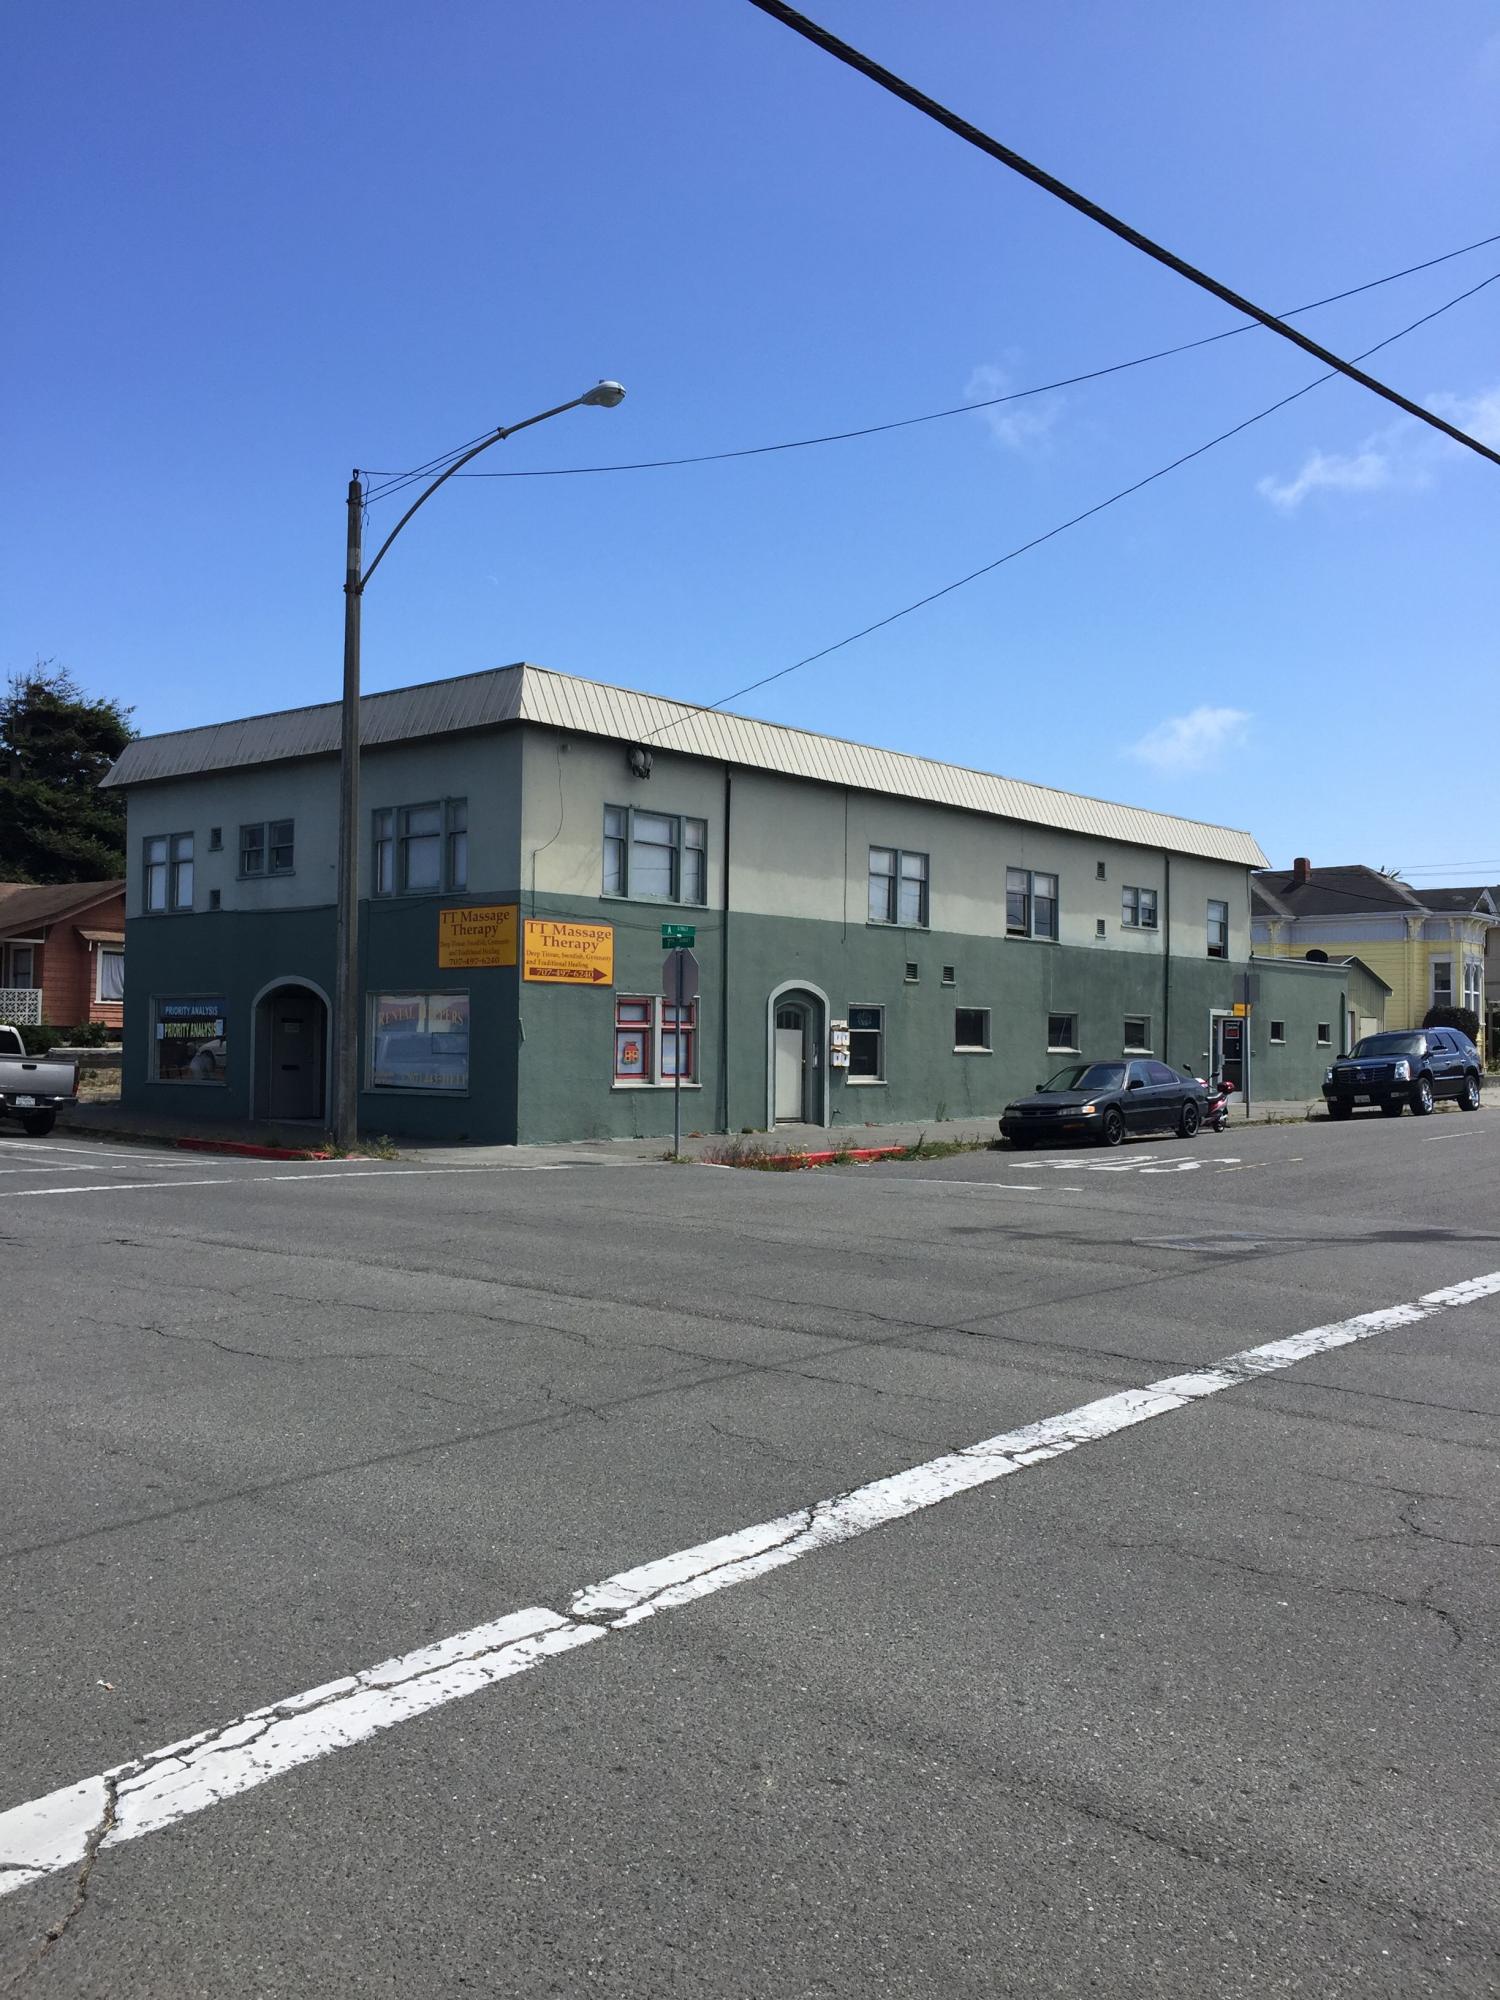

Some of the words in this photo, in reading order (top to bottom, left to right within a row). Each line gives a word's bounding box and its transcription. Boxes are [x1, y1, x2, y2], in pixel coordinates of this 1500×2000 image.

[442, 911, 457, 924] TT
[461, 911, 510, 924] Massage
[451, 924, 498, 937] Therapy
[527, 922, 548, 934] TT
[553, 924, 612, 942] Massage
[541, 935, 599, 953] Therapy
[165, 1006, 190, 1016] PRIORITY
[191, 1006, 218, 1016] ANALYSIS
[165, 1023, 190, 1038] PRIORITY
